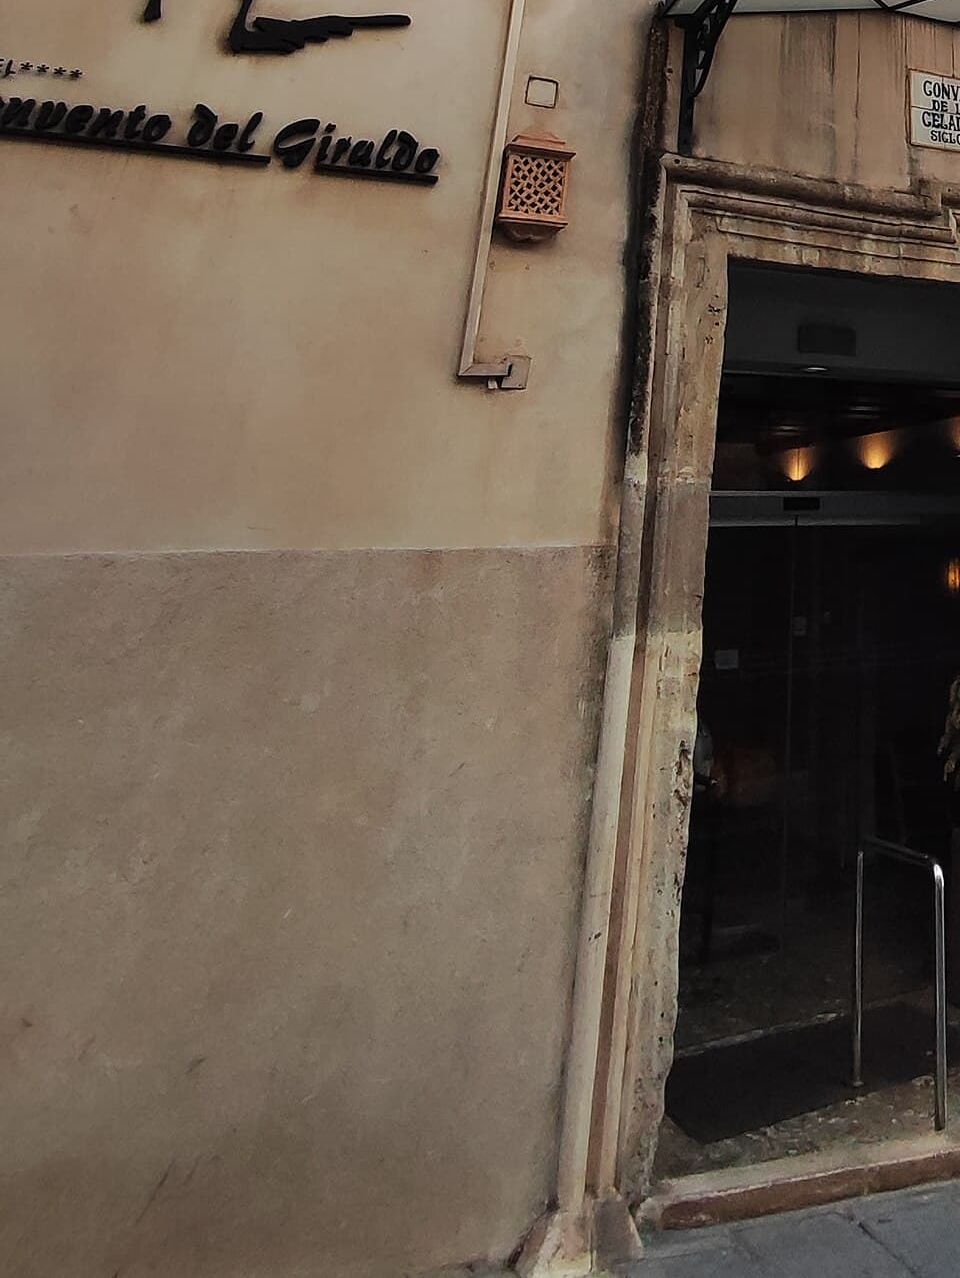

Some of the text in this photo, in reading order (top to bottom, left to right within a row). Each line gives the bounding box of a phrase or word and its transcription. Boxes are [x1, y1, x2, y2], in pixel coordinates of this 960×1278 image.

[931, 99, 949, 113] DE
[0, 96, 440, 173] nvento del Giraldo
